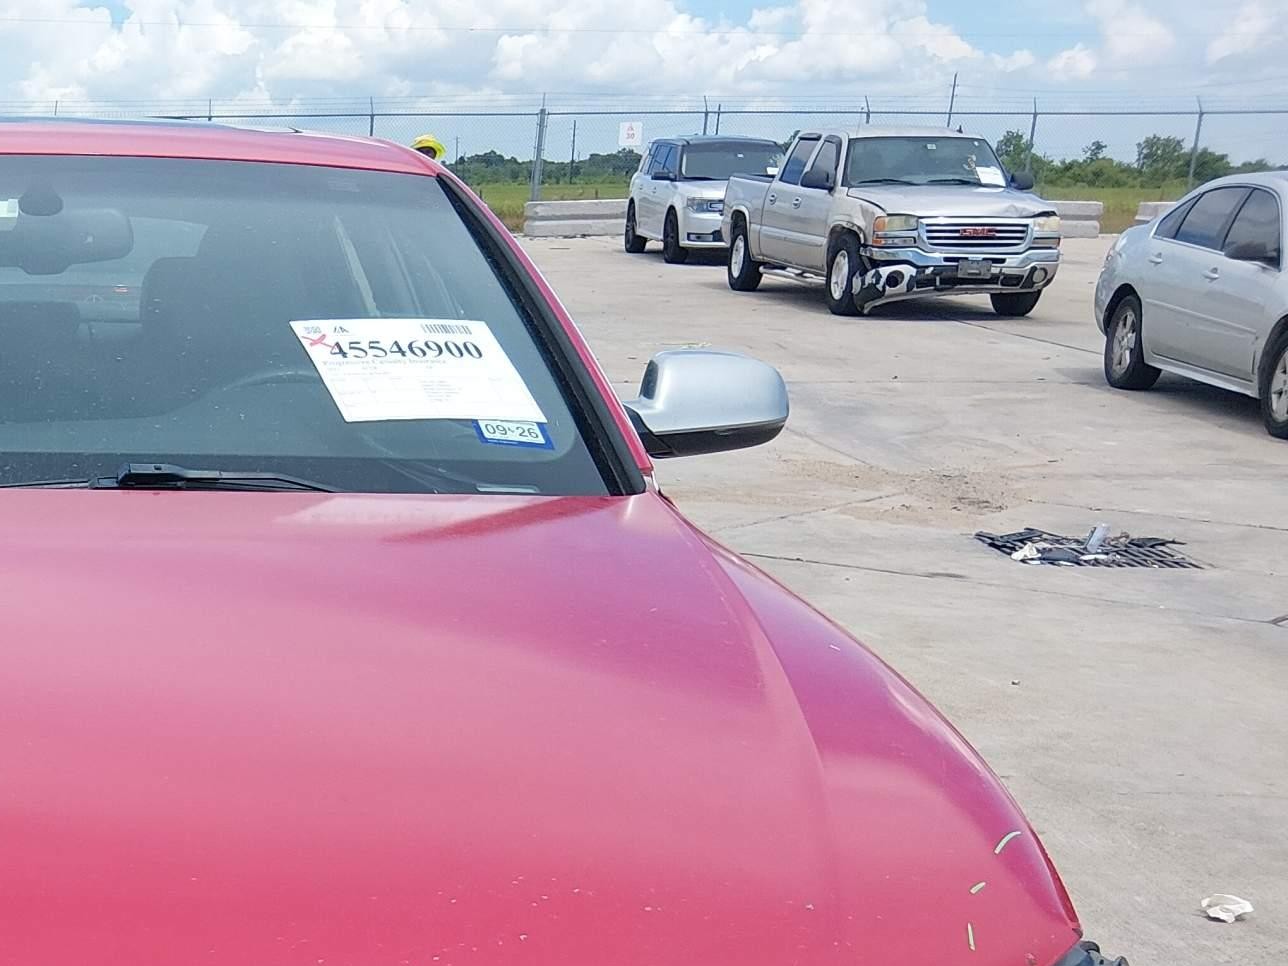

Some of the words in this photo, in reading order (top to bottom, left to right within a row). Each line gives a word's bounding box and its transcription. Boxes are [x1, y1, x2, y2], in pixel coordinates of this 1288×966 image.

[329, 339, 484, 359] 45546900
[484, 423, 508, 436] 09
[515, 426, 539, 439] 26
